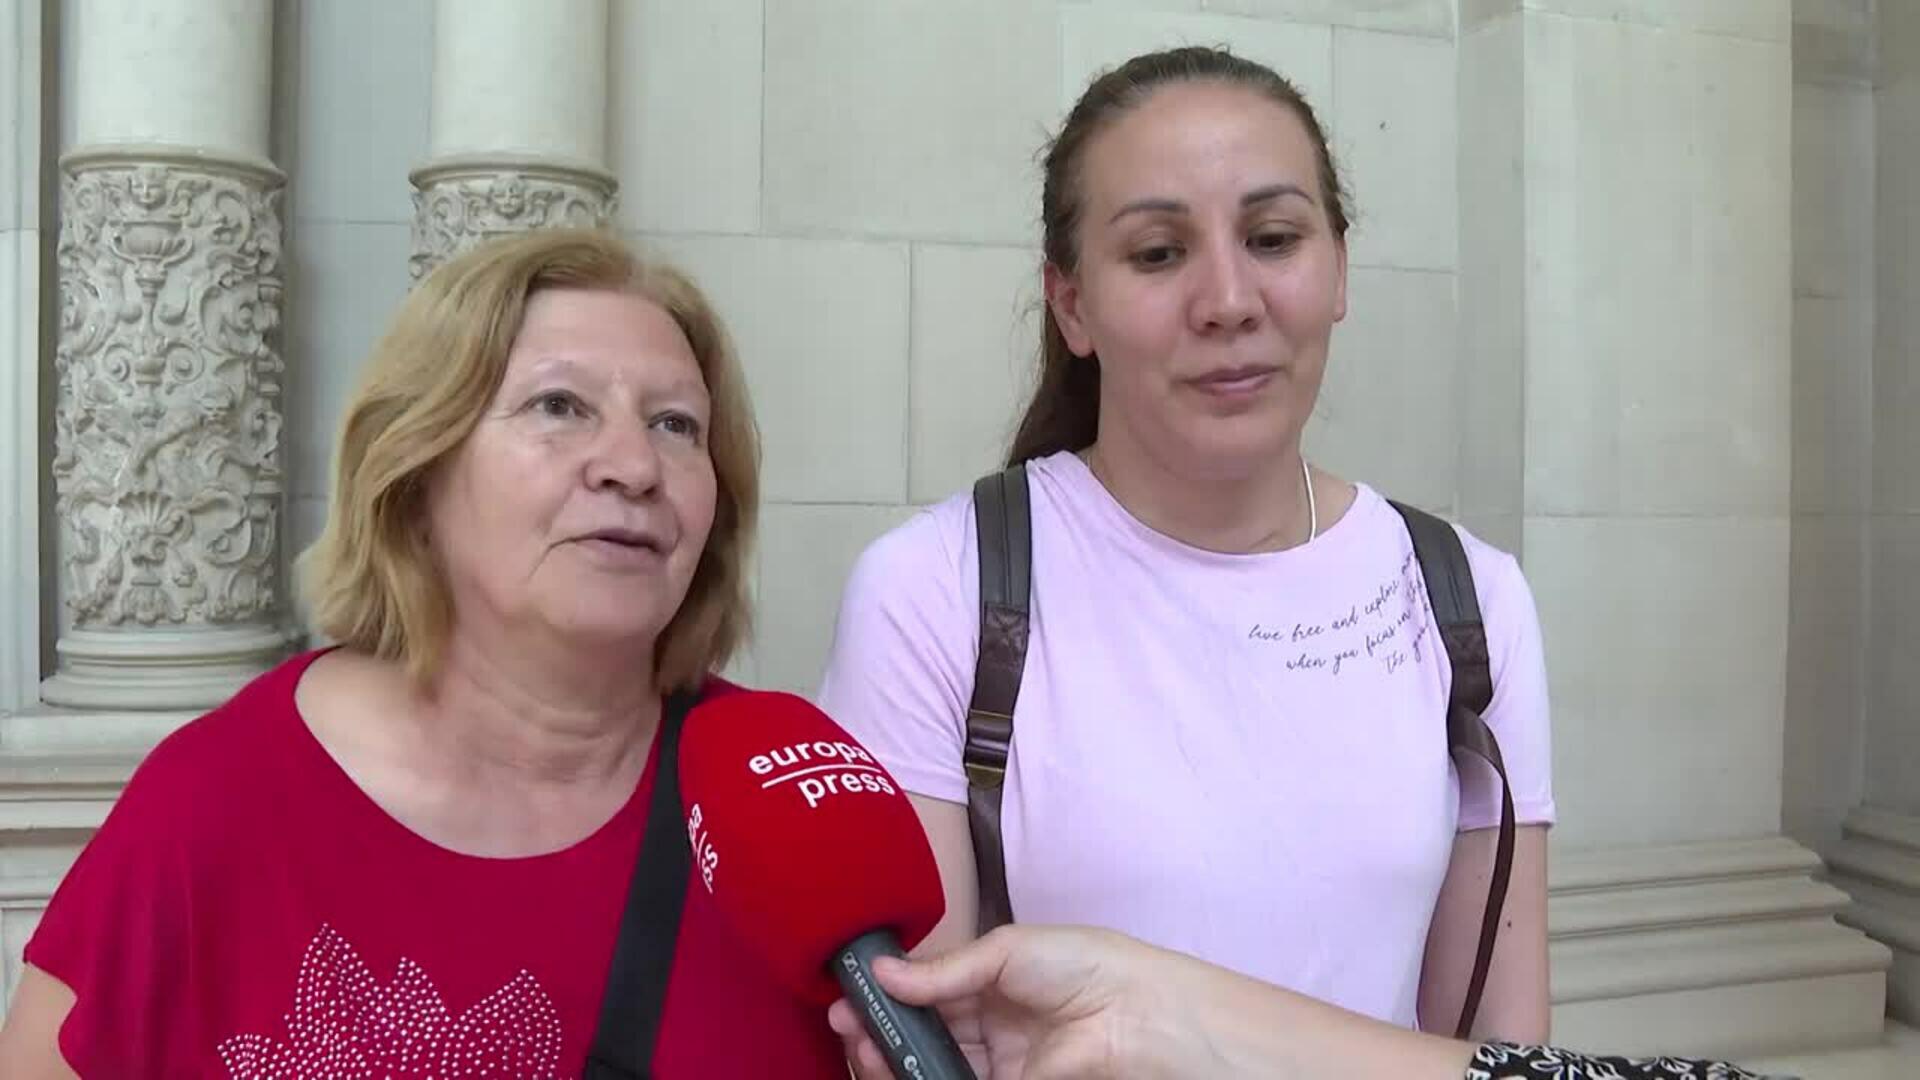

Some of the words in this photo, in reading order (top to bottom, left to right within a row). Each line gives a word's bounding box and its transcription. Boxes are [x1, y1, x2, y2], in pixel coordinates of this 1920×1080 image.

[1291, 623, 1325, 642] free
[1331, 605, 1358, 628] and
[1286, 653, 1327, 670] when
[1332, 649, 1358, 676] you
[1365, 625, 1396, 657] focus
[748, 741, 874, 775] europa
[797, 772, 896, 808] press
[853, 970, 903, 1047] SENNHEISER
